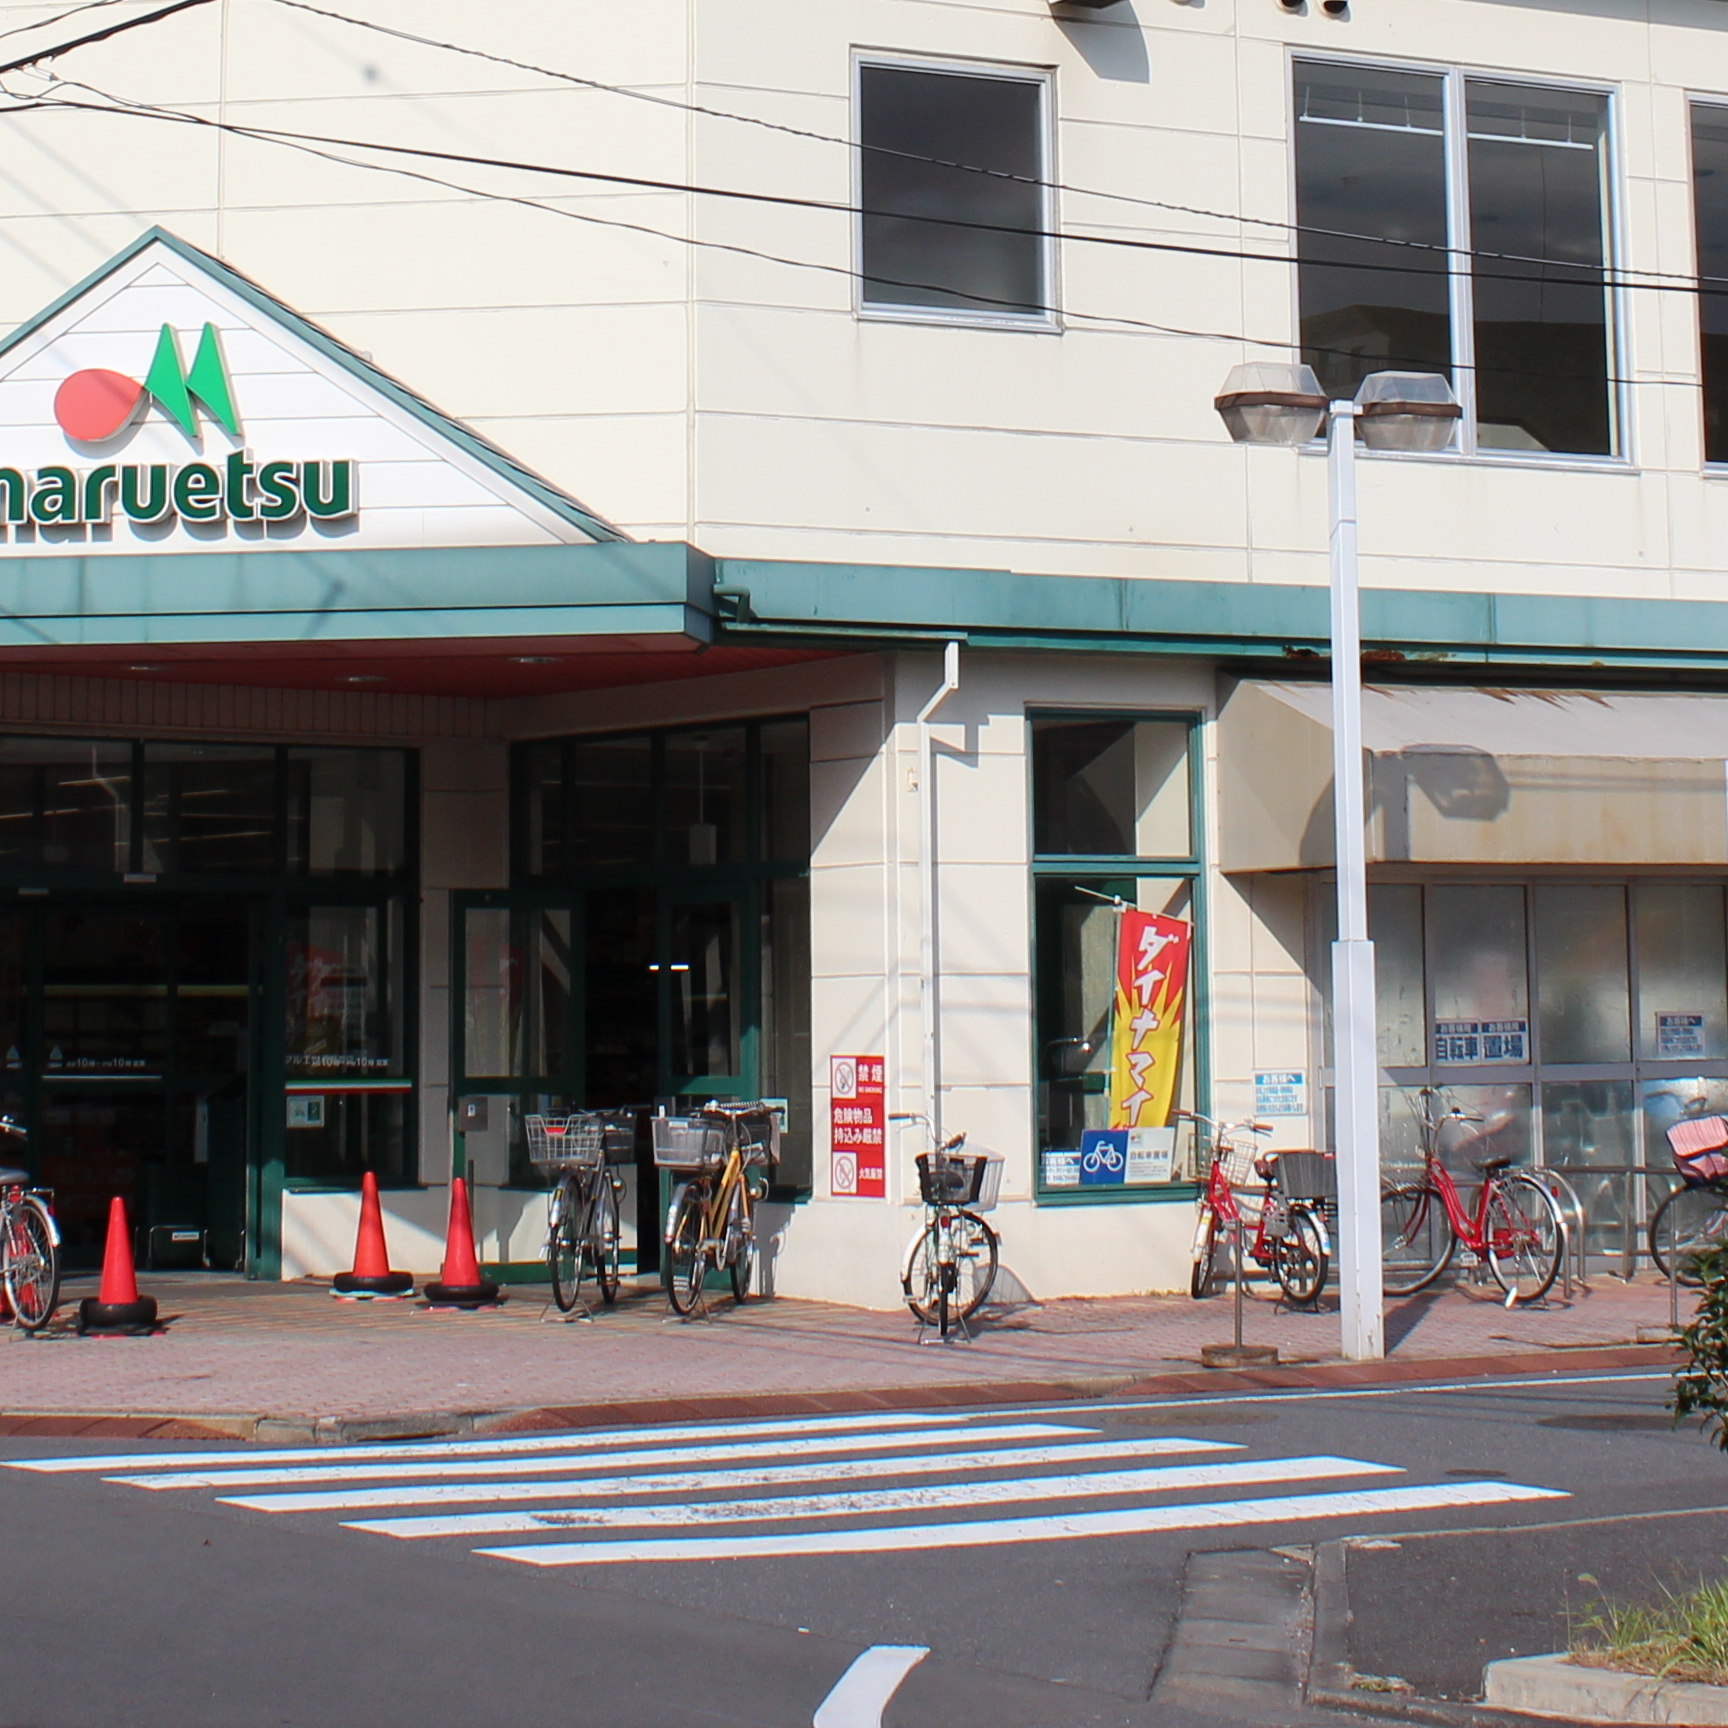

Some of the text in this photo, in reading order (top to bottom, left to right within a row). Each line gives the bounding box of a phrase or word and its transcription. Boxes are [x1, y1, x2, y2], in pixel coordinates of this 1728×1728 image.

[1122, 925, 1179, 1129] ダイナマイ
[858, 1063, 883, 1083] 禁煙
[834, 1107, 873, 1124] 危険物品
[834, 1127, 883, 1145] 持込み厳禁
